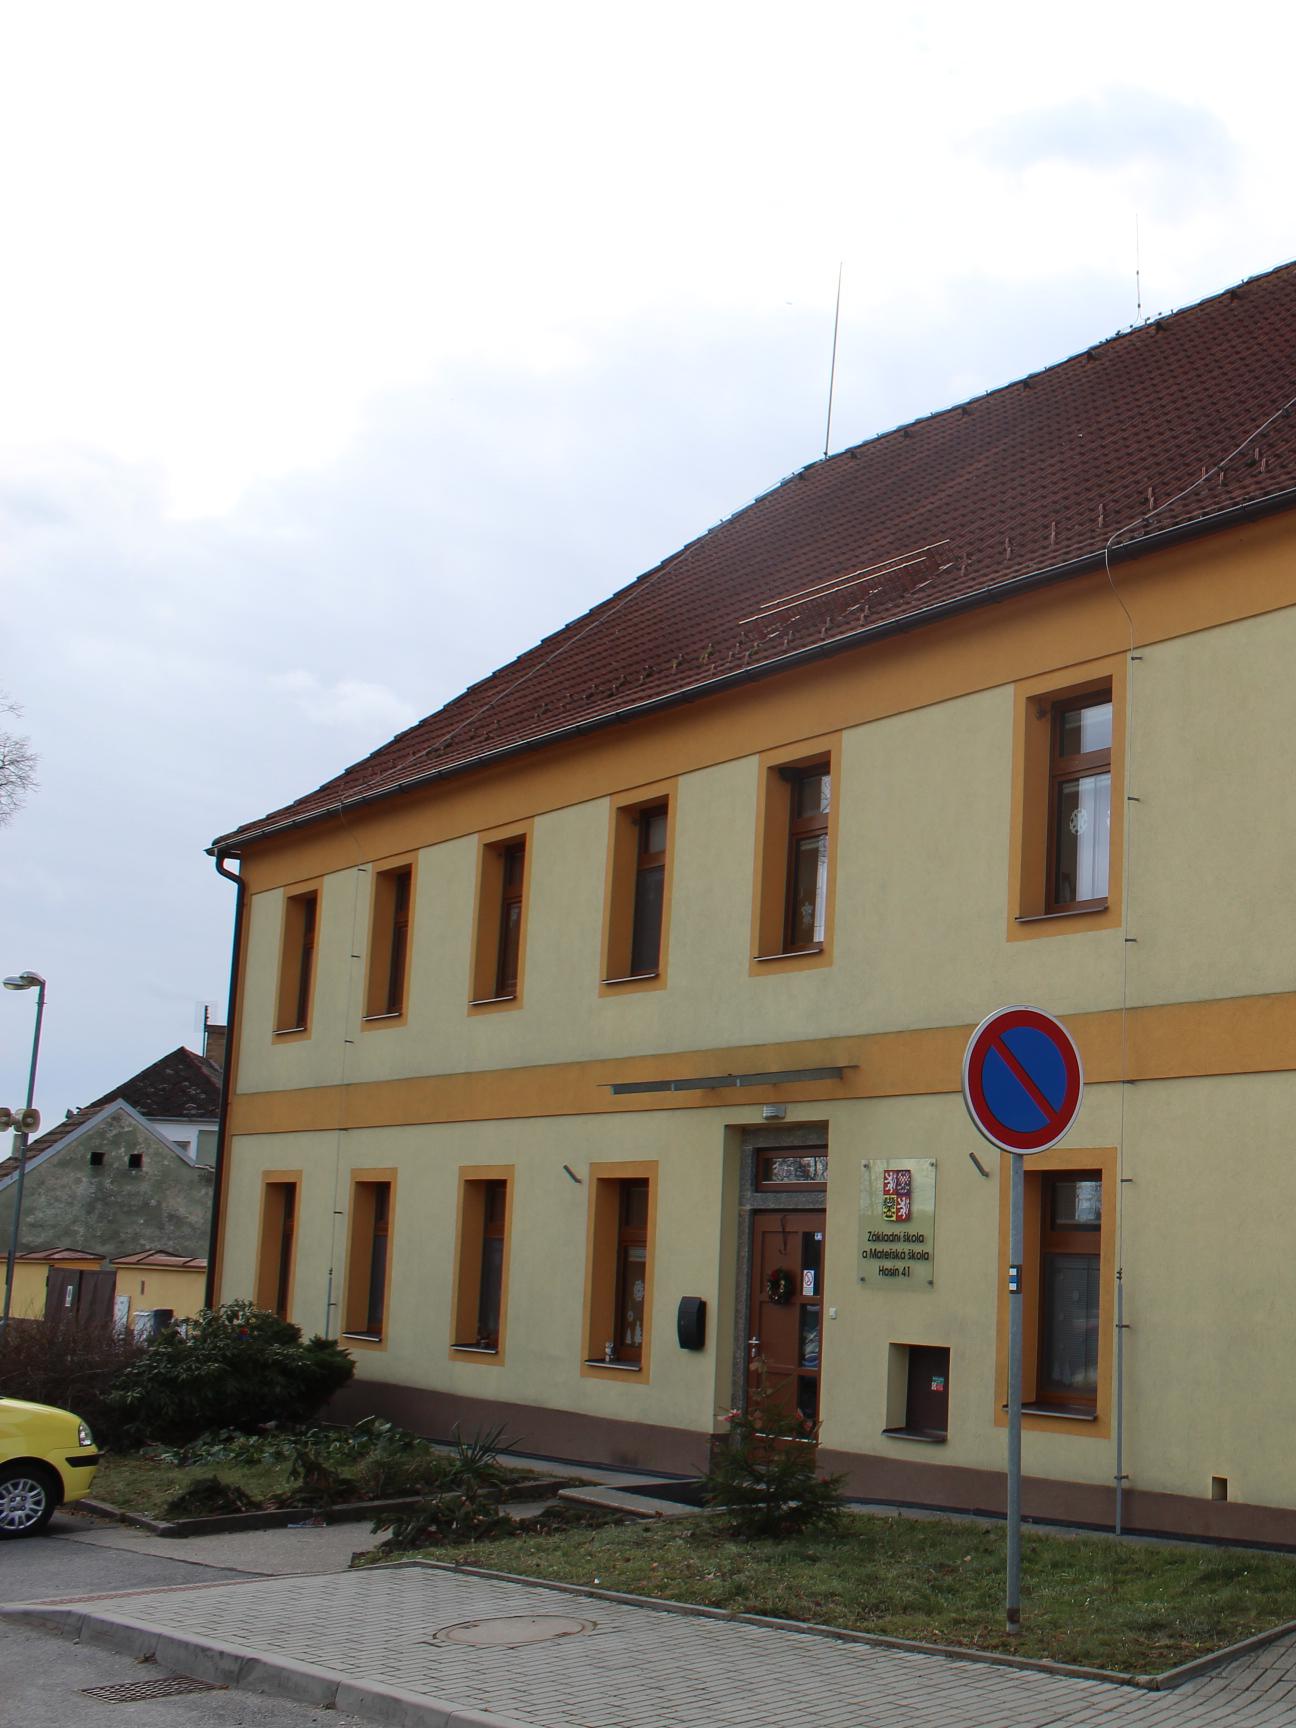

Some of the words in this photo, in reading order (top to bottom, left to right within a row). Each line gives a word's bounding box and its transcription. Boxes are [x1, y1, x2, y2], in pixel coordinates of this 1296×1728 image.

[867, 1230, 902, 1243] Základní
[902, 1231, 925, 1243] škola
[862, 1250, 868, 1259] a
[869, 1248, 906, 1260] Mateřská
[907, 1248, 930, 1261] škola
[901, 1265, 911, 1277] 41
